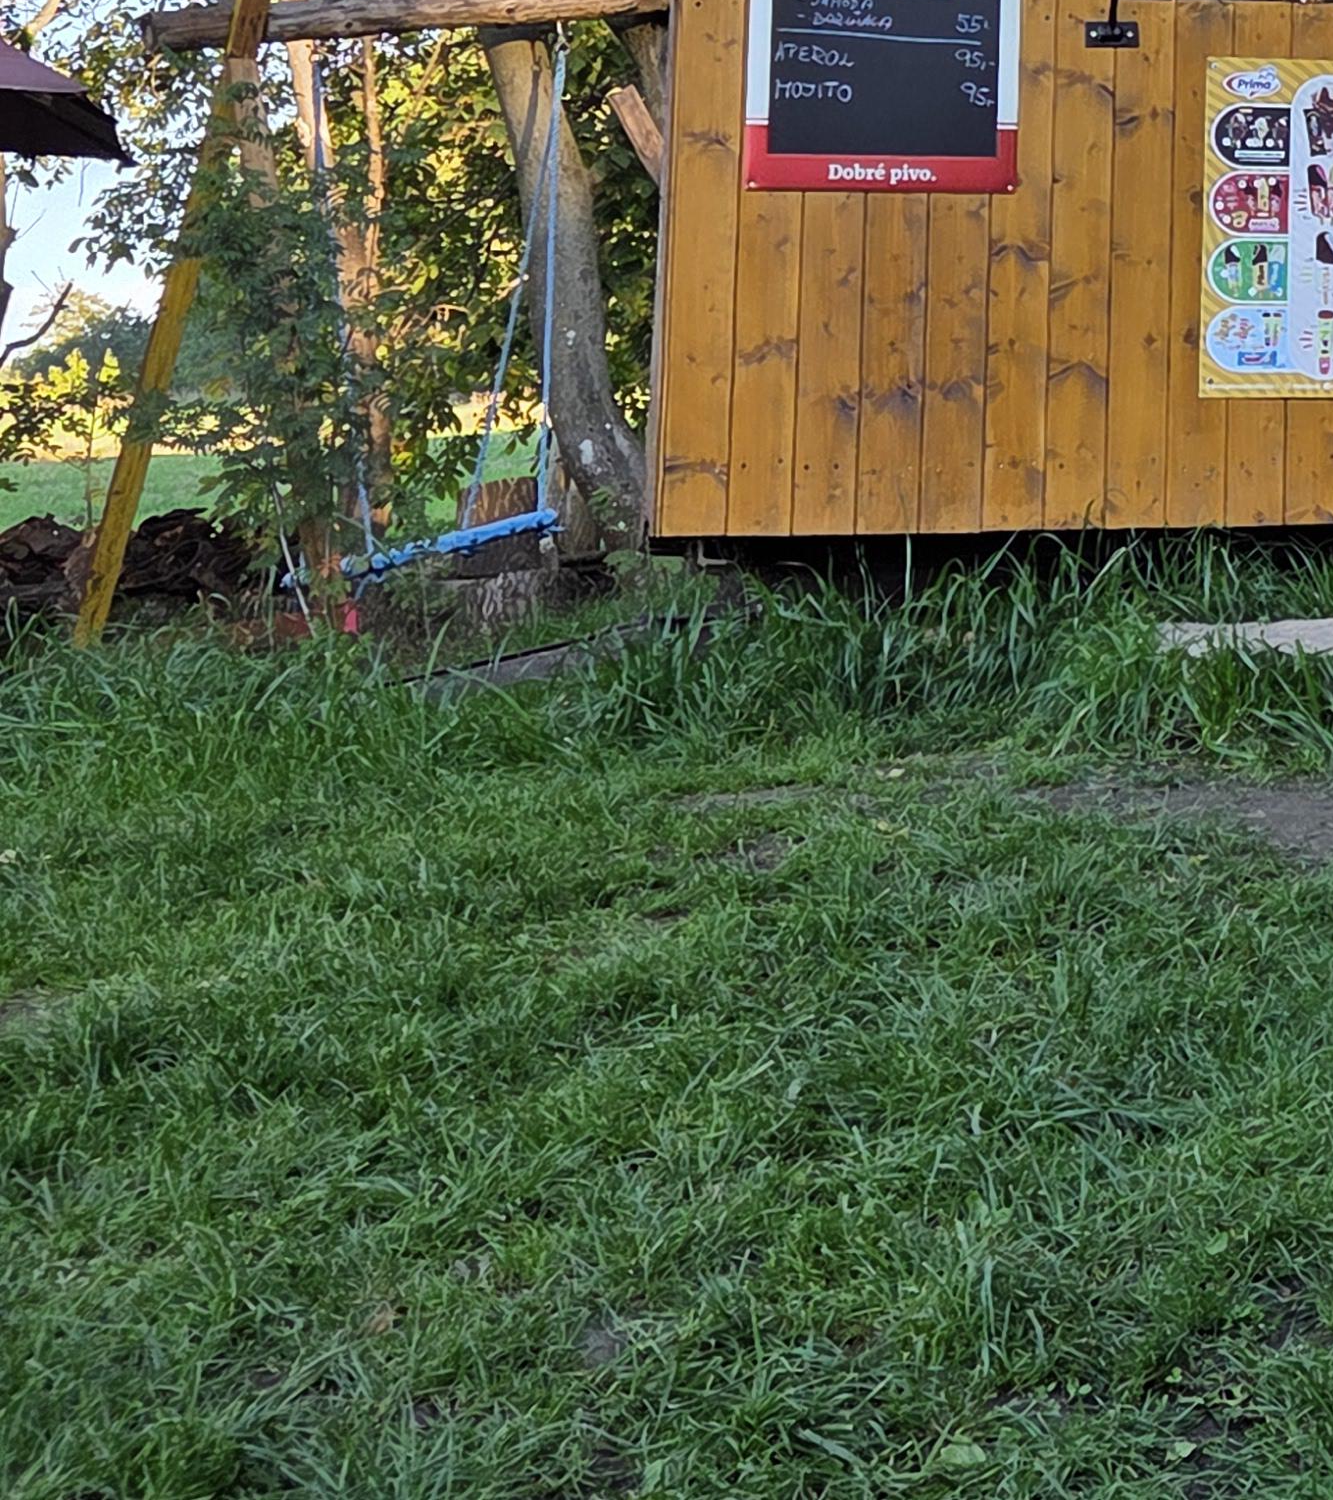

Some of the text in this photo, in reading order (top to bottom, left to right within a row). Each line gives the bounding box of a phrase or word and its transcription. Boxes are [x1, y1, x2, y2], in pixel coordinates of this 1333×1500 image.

[774, 41, 855, 67] APEROL
[774, 79, 853, 103] MOJITO
[1237, 78, 1271, 89] Prima
[828, 163, 937, 184] Dobré pivo.
